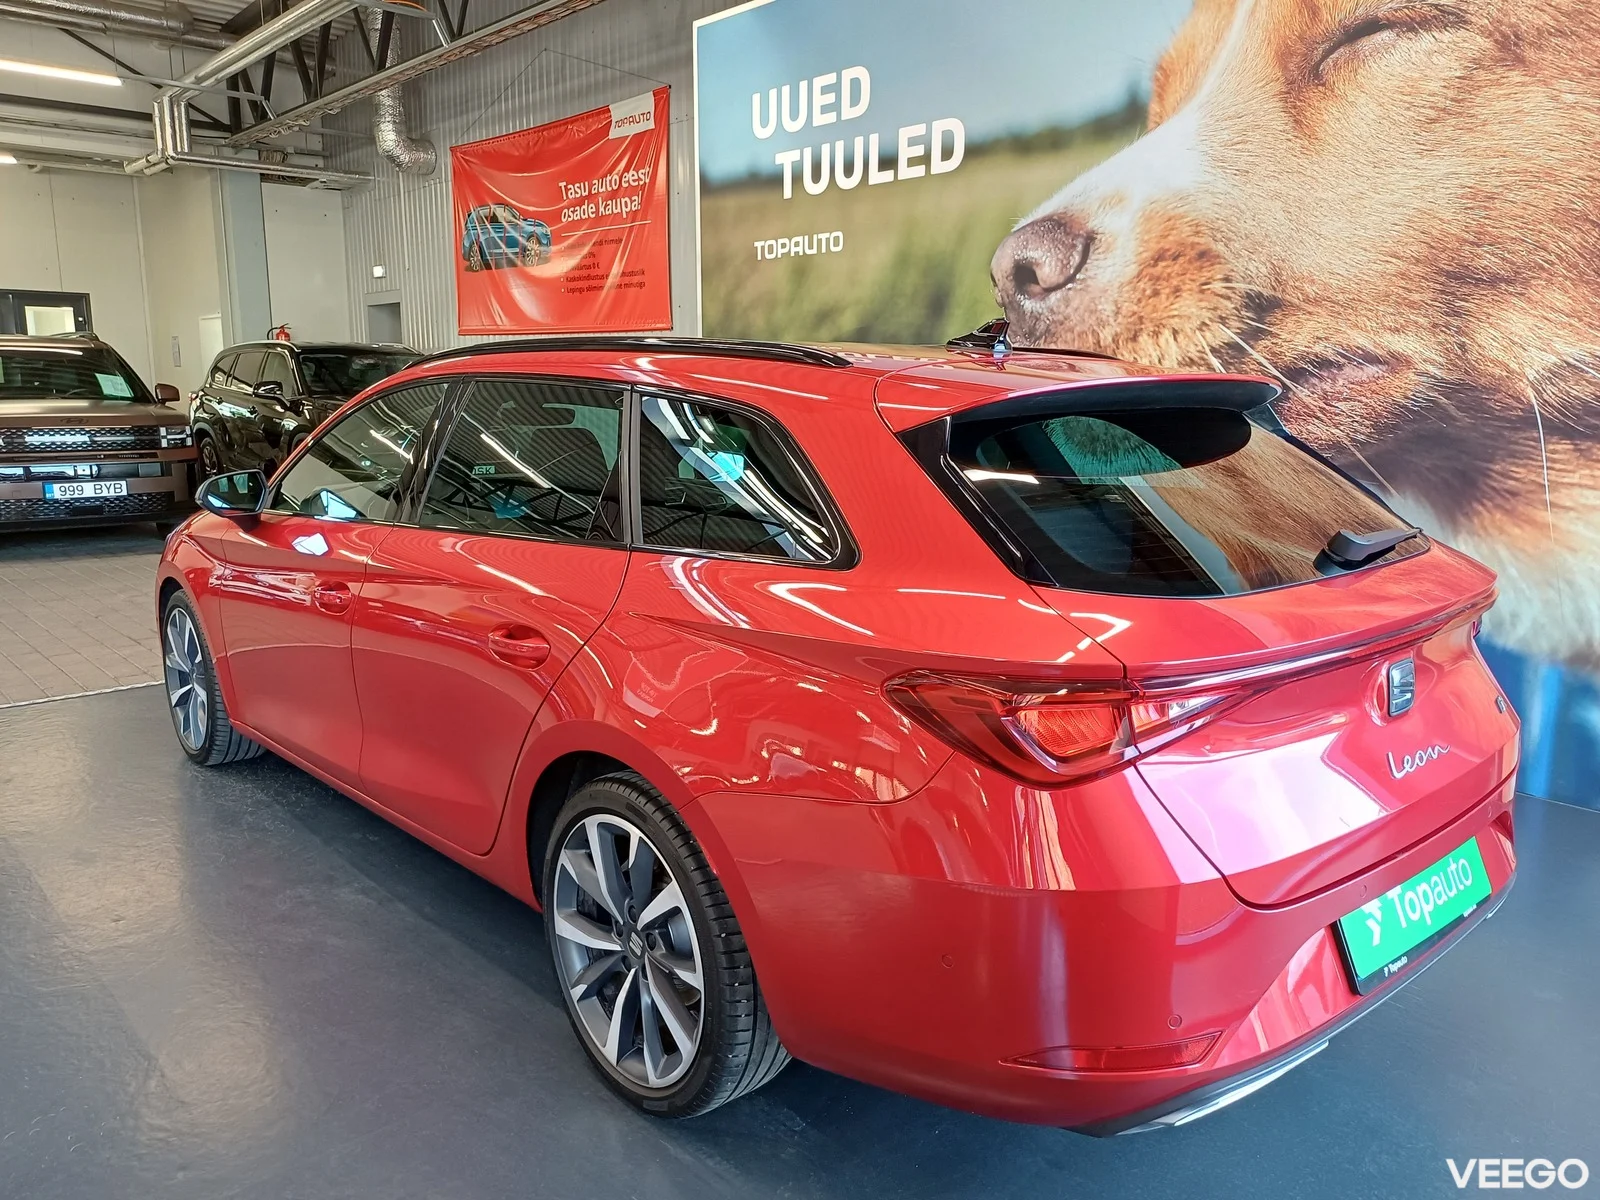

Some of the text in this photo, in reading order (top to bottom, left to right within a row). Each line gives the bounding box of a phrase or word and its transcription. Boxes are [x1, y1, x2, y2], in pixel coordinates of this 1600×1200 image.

[752, 65, 871, 139] UUED
[613, 111, 652, 129] TOPAUTO
[774, 117, 965, 200] TUULED
[558, 167, 650, 200] Tasu auto eest
[561, 191, 642, 222] osade kaupa!
[753, 231, 844, 261] TOPAUTO
[58, 482, 124, 497] 999 BYB
[1385, 745, 1452, 780] Leon
[1385, 856, 1474, 929] Topauto
